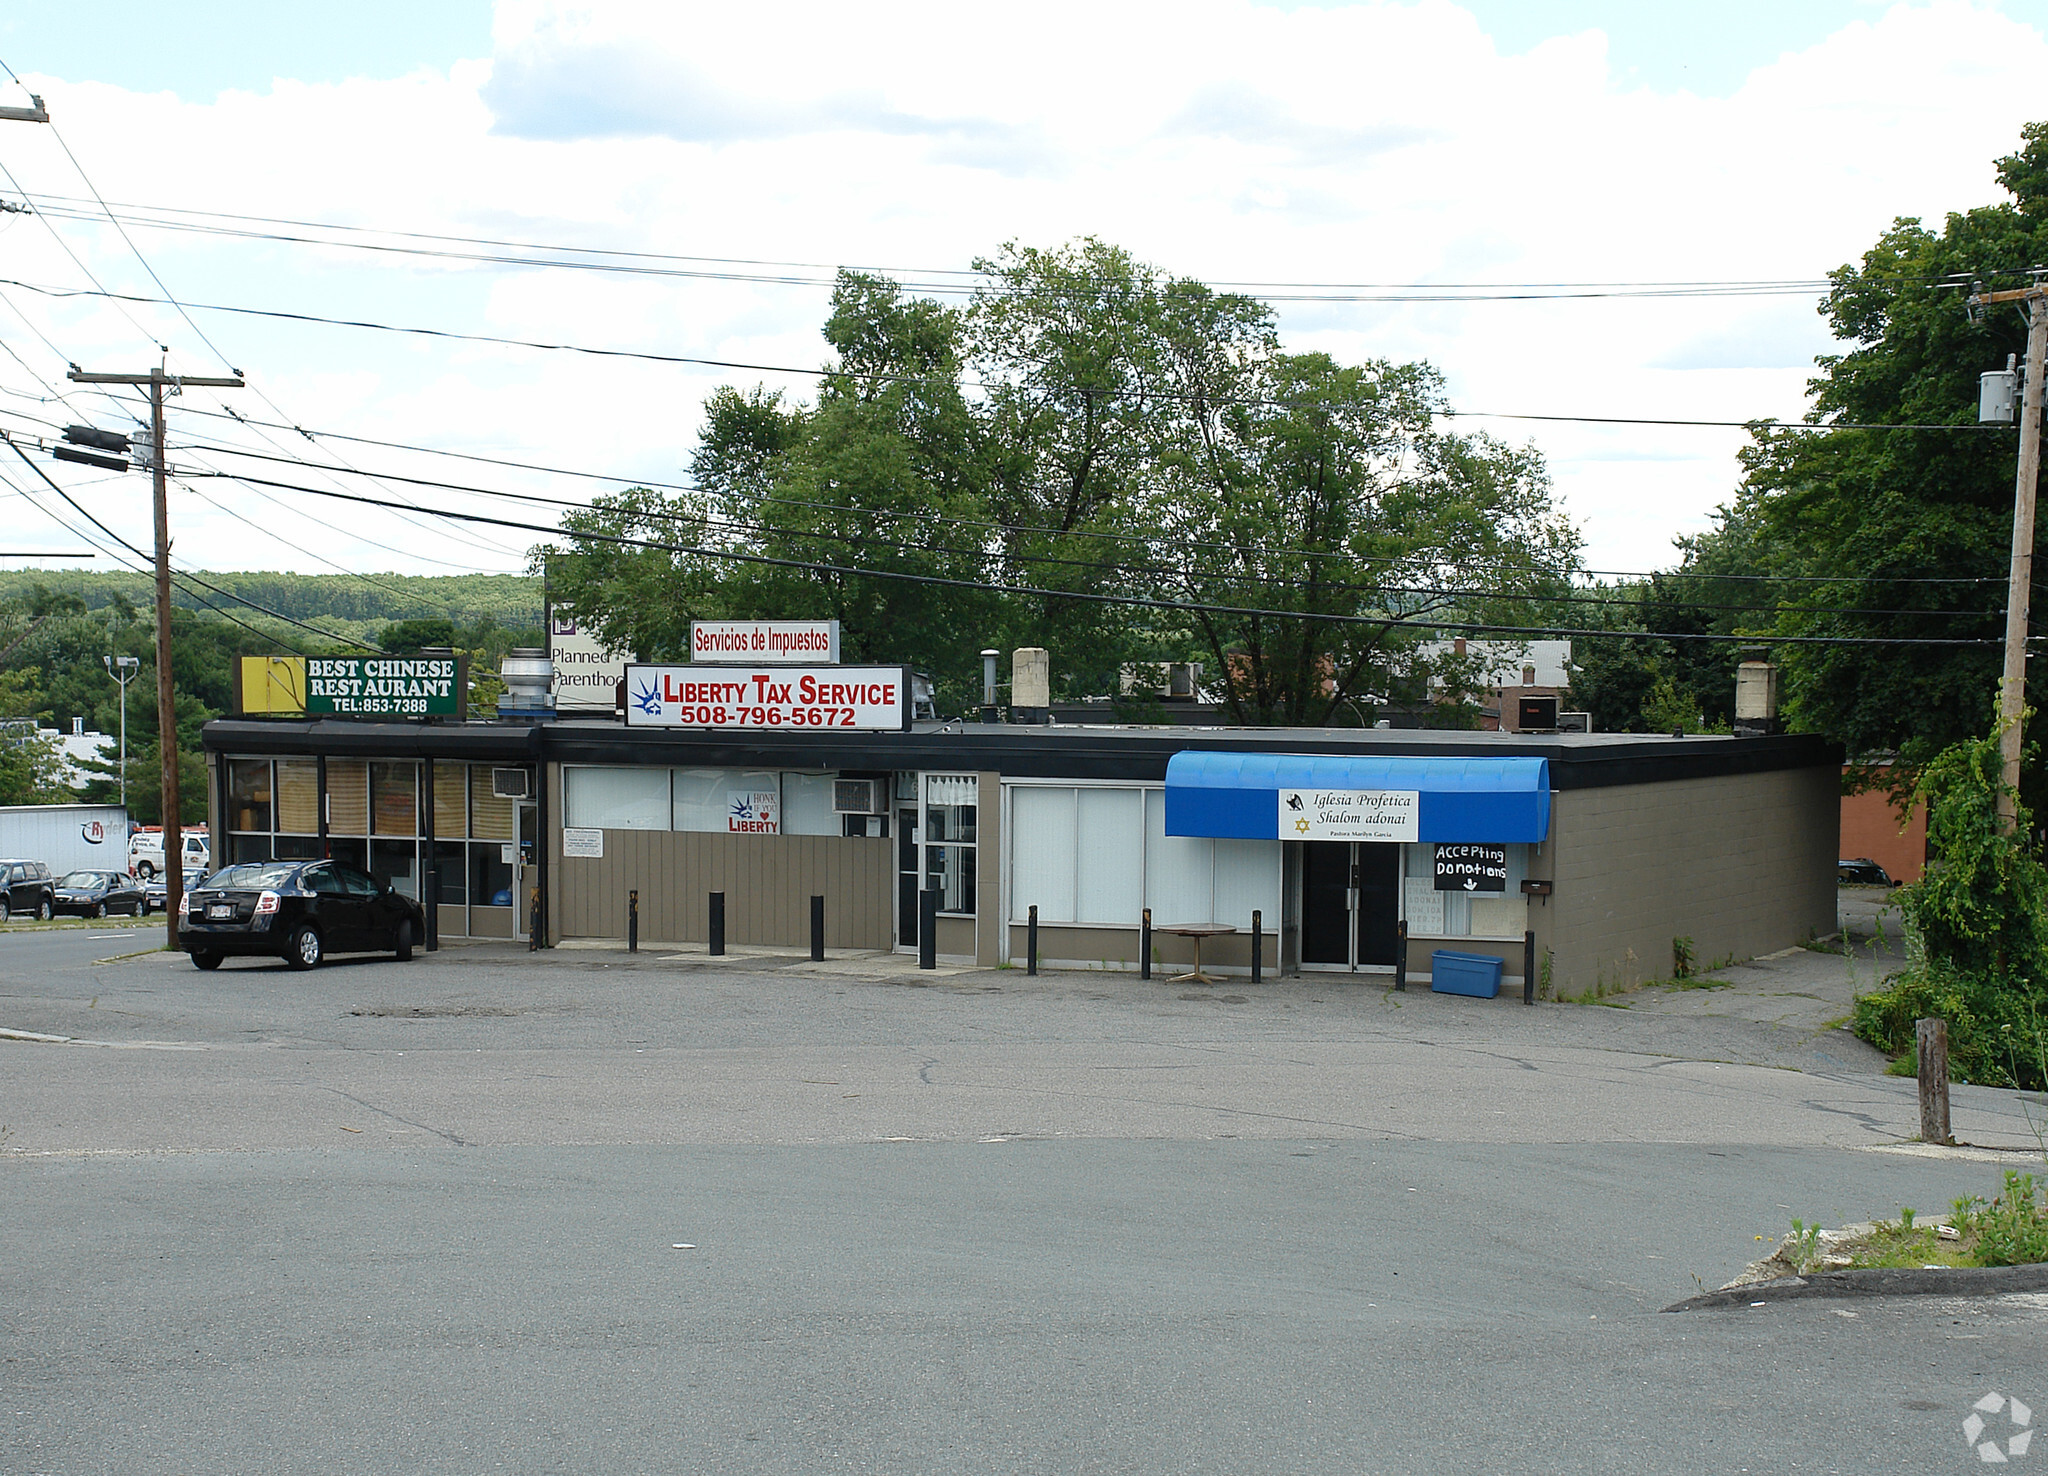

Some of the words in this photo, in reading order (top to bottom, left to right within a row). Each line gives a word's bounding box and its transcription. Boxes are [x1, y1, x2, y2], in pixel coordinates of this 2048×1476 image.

[695, 627, 748, 652] Servicios
[750, 628, 767, 651] de
[767, 627, 829, 656] Impuestos
[552, 647, 610, 664] Planned
[308, 660, 359, 677] BEST
[364, 660, 454, 678] CHINESE
[310, 679, 452, 697] RESTAURANT
[663, 674, 748, 704] LIBERTY
[751, 674, 793, 705] TAX
[799, 674, 896, 706] SERVICE
[332, 698, 428, 713] TEL:853-7388
[680, 705, 856, 727] 508-796-5672
[753, 792, 777, 804] HONK
[1313, 793, 1353, 807] Iglesia
[1356, 793, 1411, 809] Profetica
[753, 804, 761, 812] IF
[763, 804, 778, 813] YOU
[728, 816, 779, 834] LIBERTY
[1316, 811, 1361, 824] Shalom
[1365, 812, 1407, 825] adonai
[92, 820, 123, 839] Ryder
